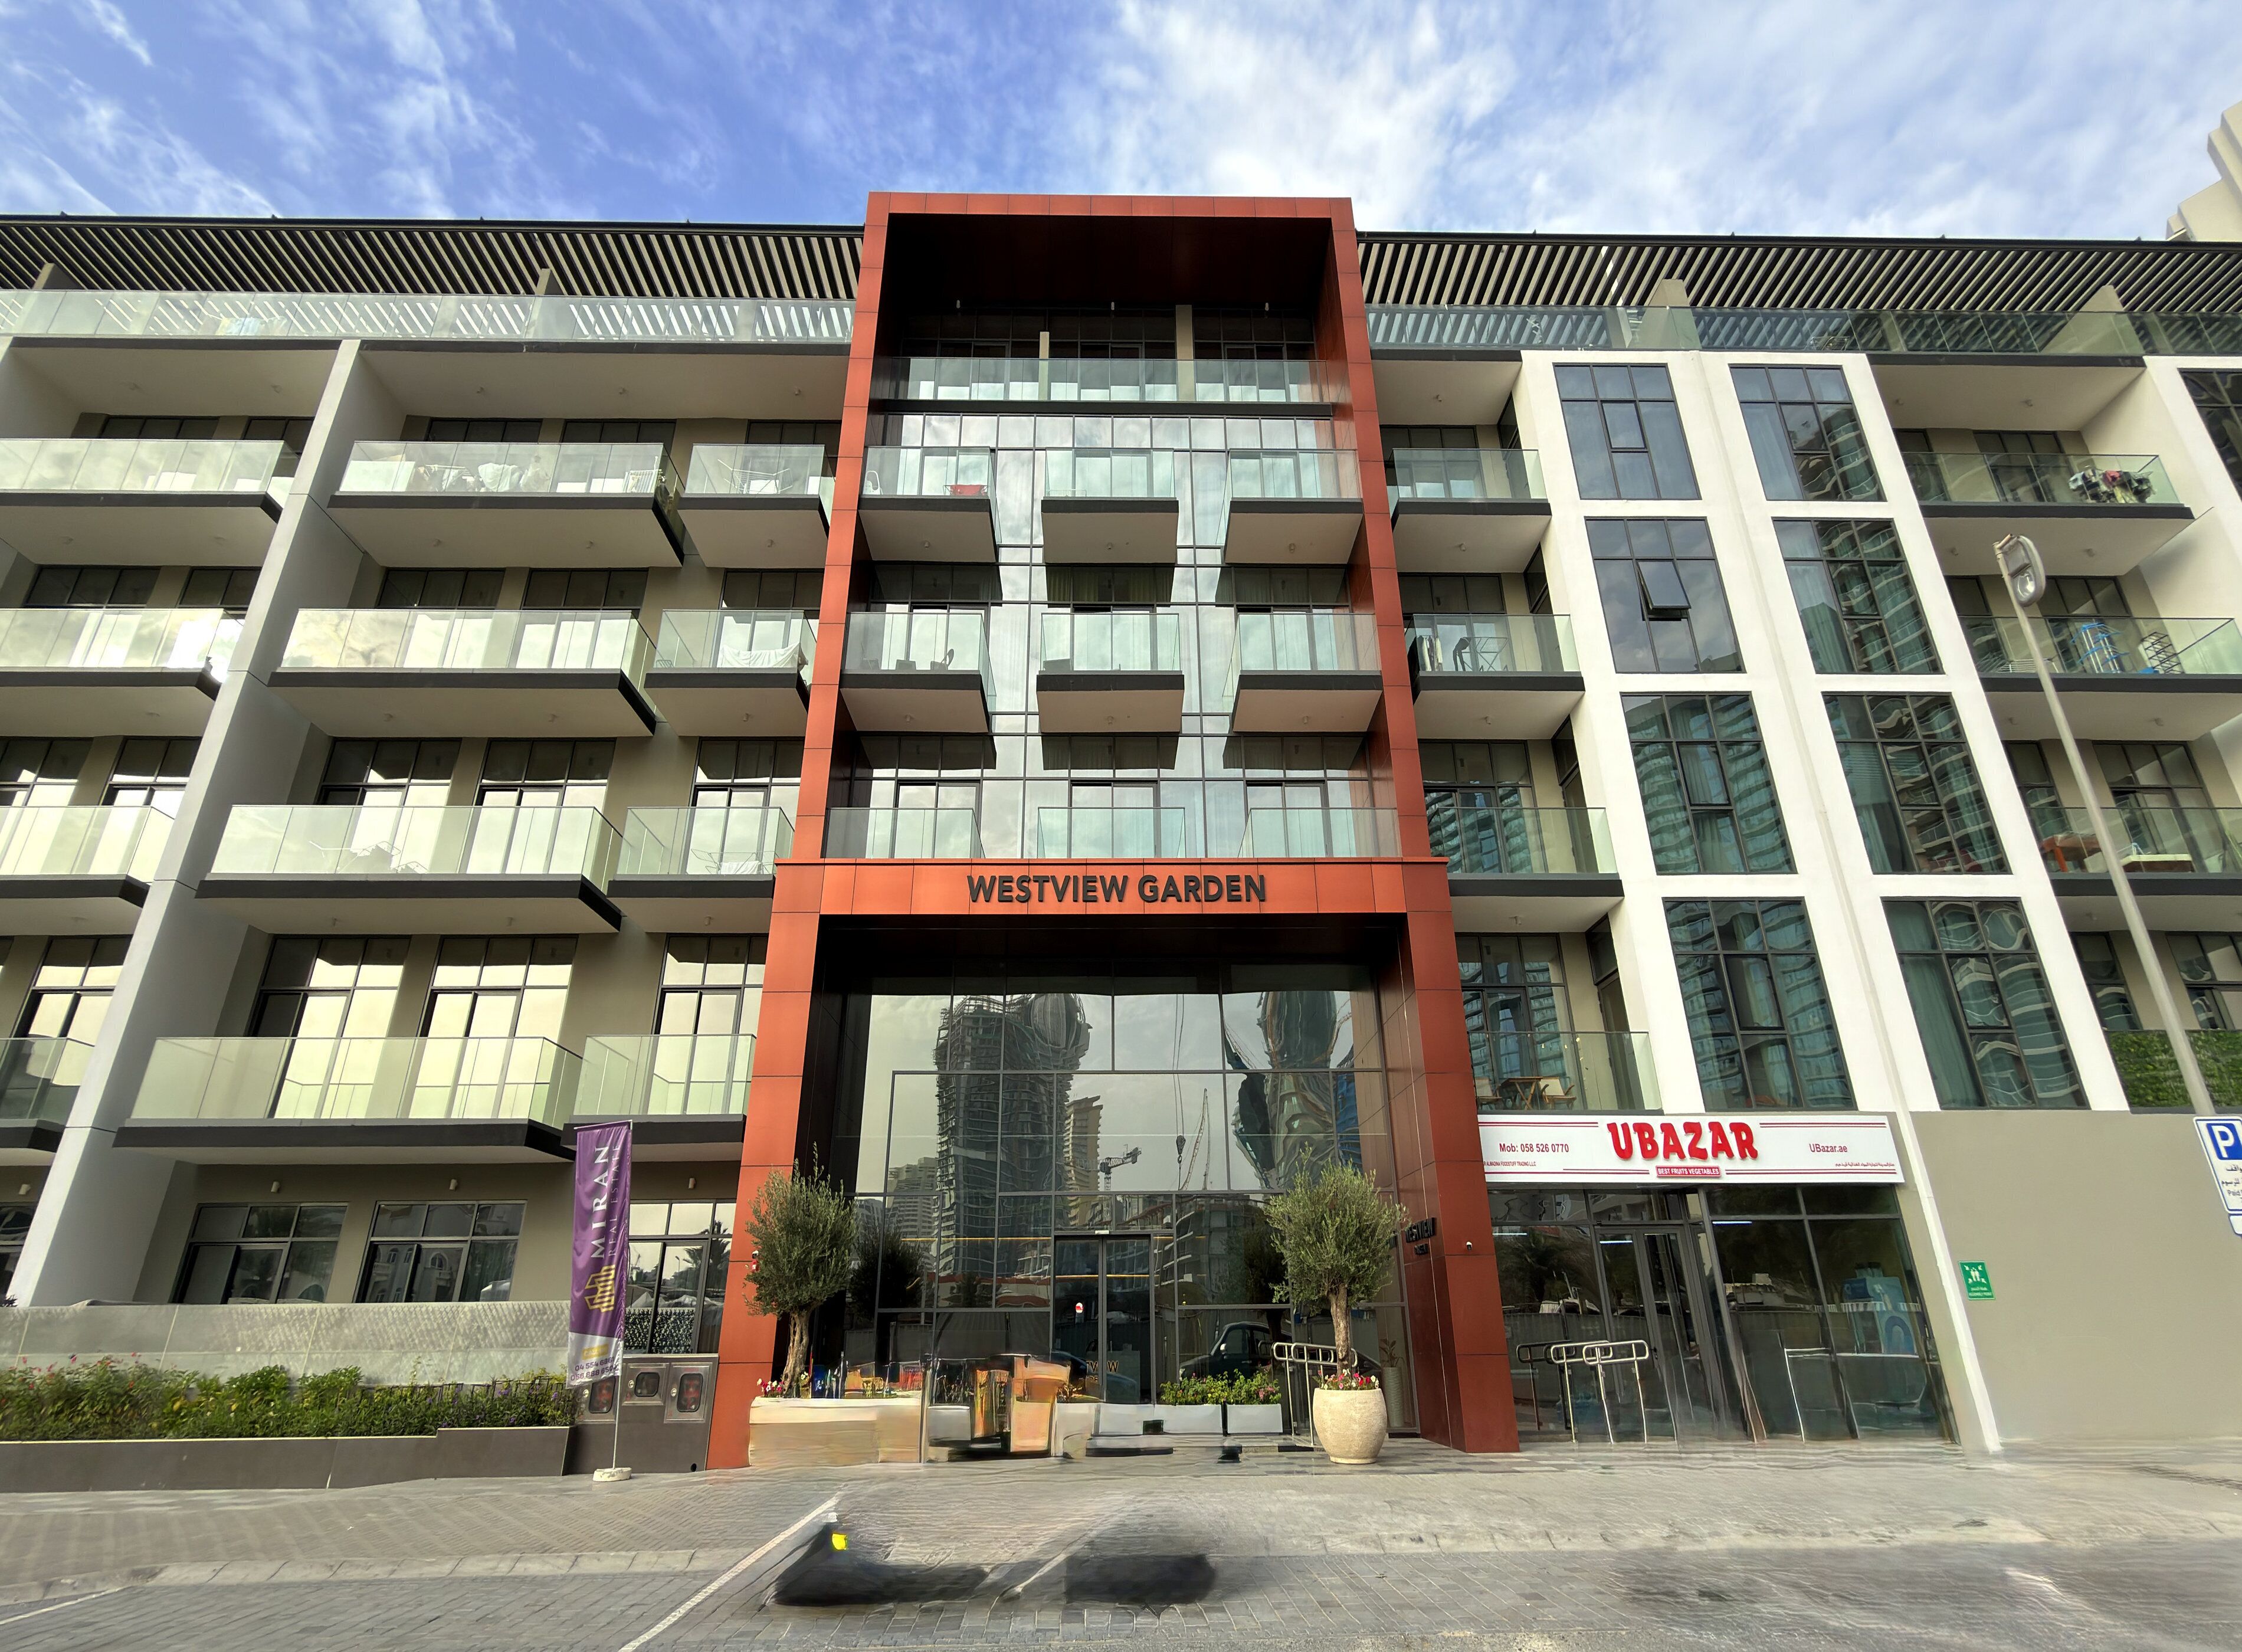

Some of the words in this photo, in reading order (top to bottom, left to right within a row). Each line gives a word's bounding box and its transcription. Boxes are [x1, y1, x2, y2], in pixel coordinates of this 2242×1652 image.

[966, 875, 1128, 903] WESTVIEW
[1138, 875, 1266, 903] GARDEN
[1499, 1143, 1519, 1152] Mob:
[1520, 1143, 1534, 1152] 058
[1536, 1143, 1549, 1152] 526
[1551, 1143, 1569, 1153] 0770
[1607, 1121, 1759, 1161] UBAZAR
[1809, 1143, 1848, 1153] UBazar.ae
[2211, 1125, 2235, 1158] P
[610, 1145, 620, 1204] ESTATE
[591, 1146, 609, 1258] MIRAN
[608, 1214, 618, 1257] REAL
